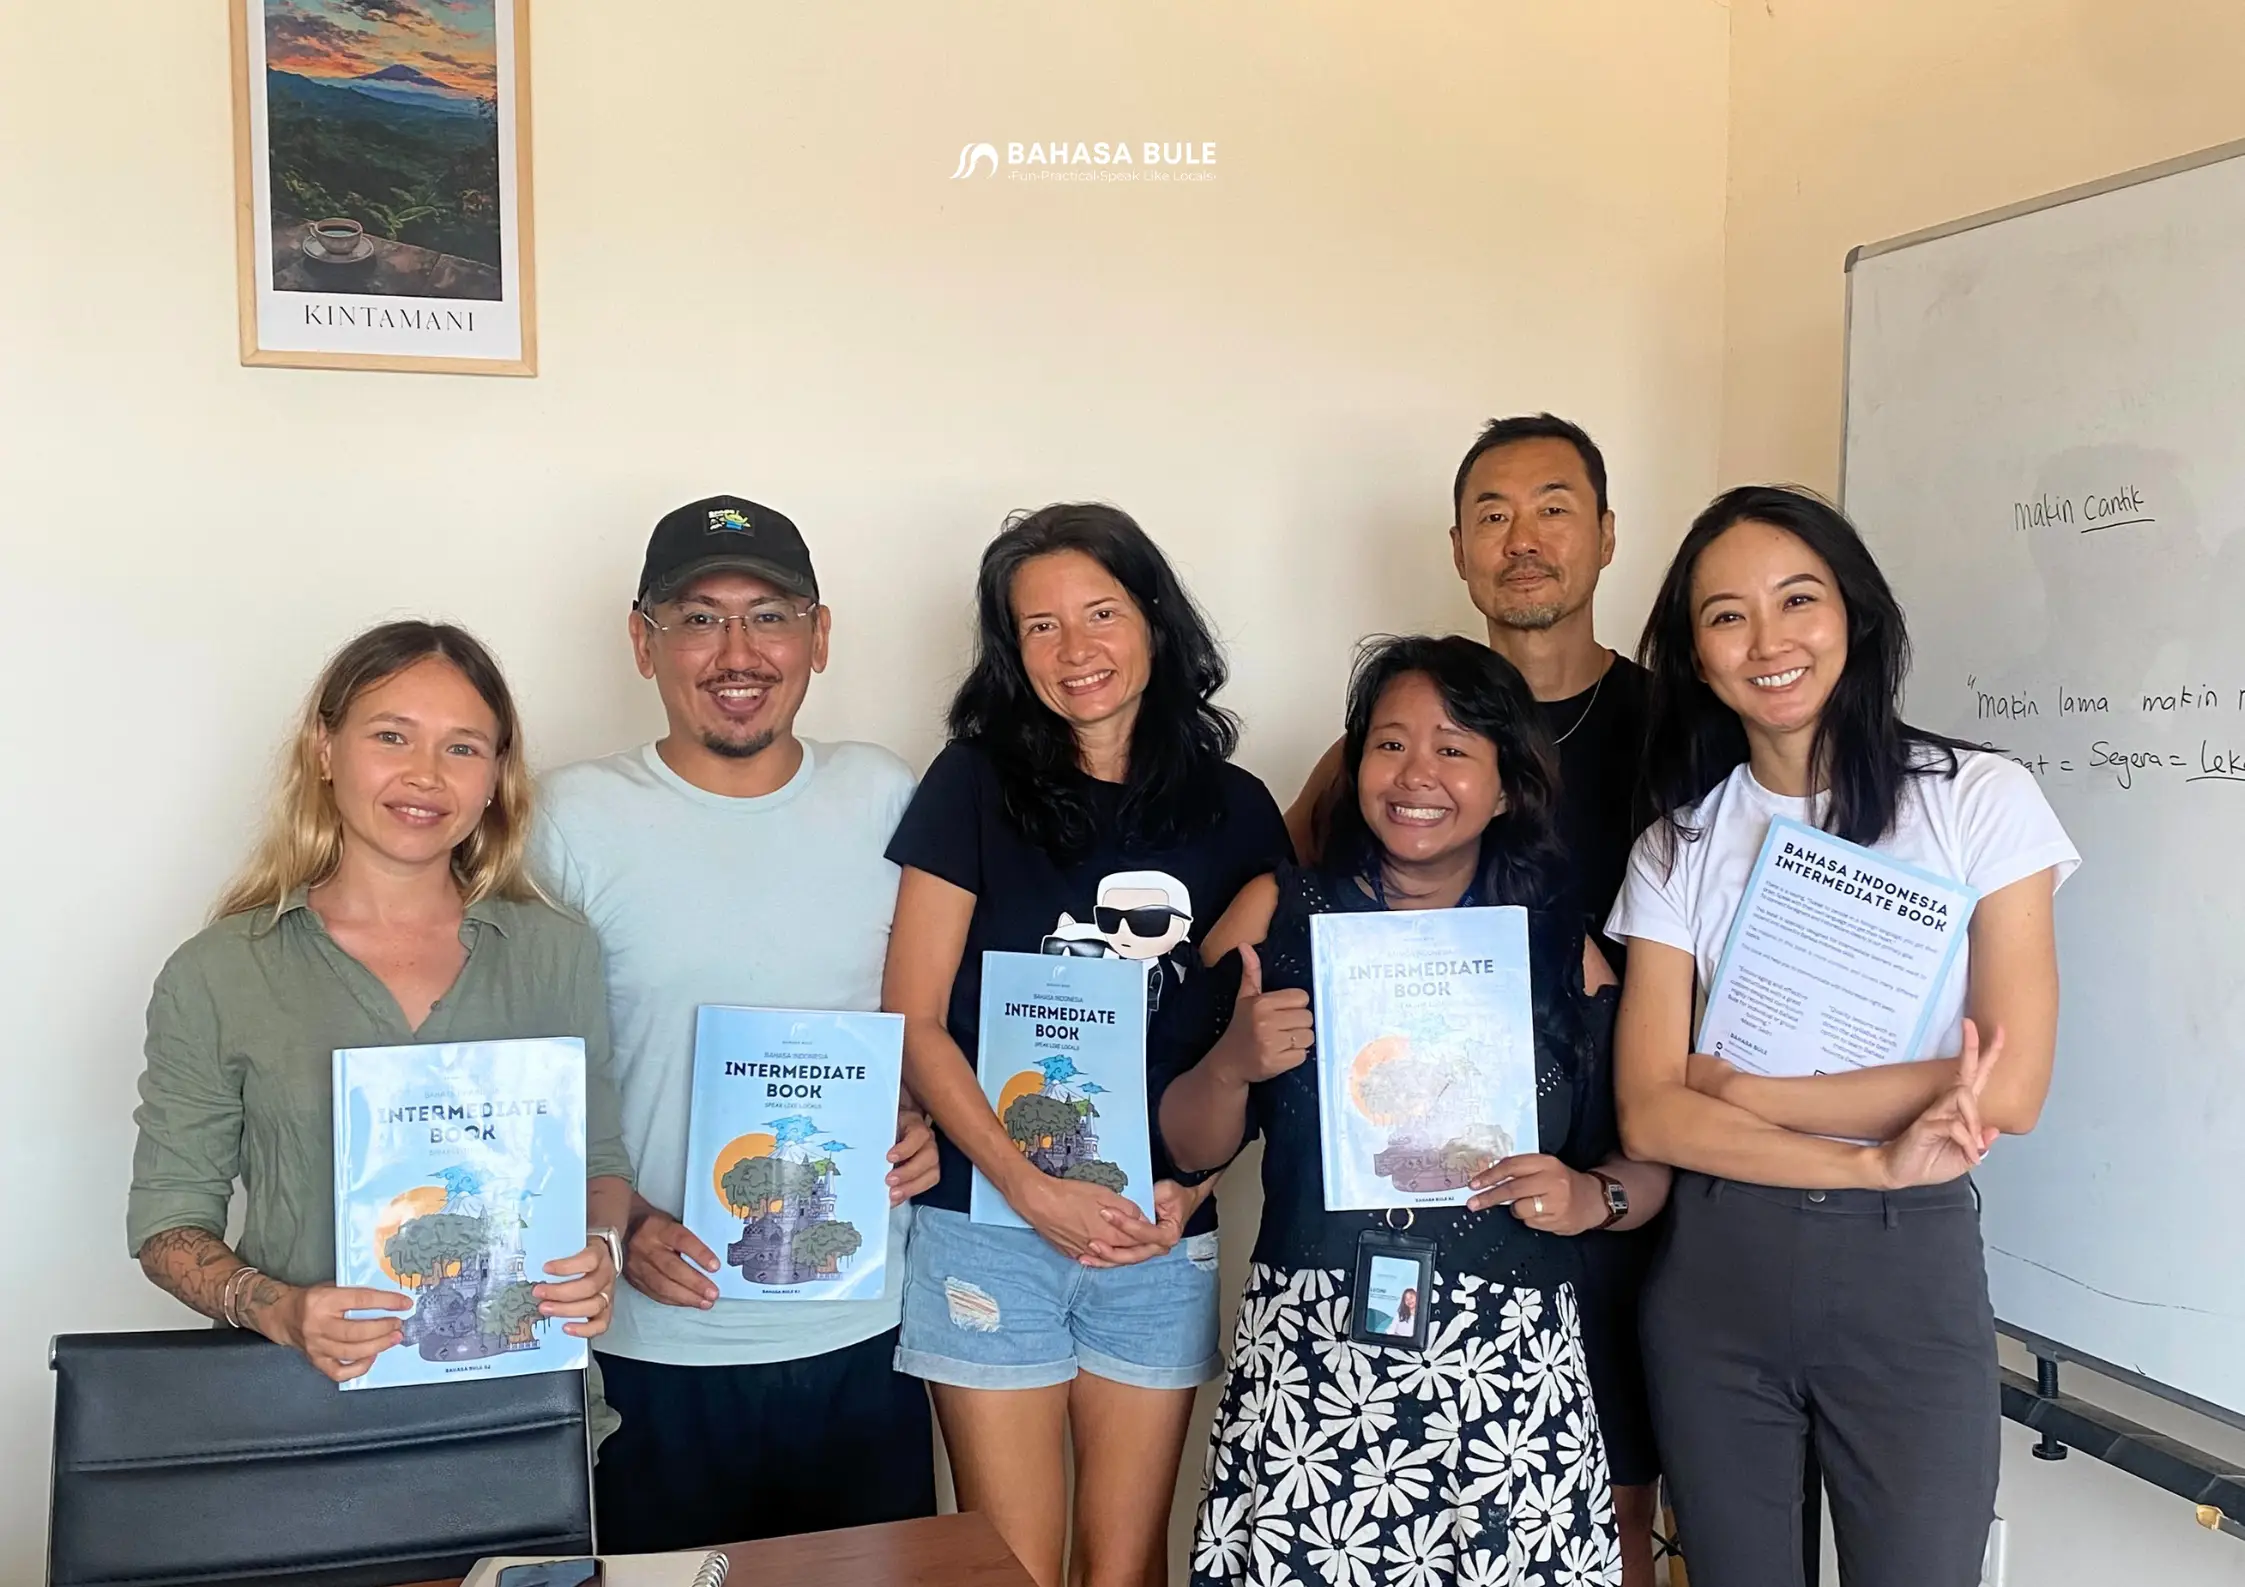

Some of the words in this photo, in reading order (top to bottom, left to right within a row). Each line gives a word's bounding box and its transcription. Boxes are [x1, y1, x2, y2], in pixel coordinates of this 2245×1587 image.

[305, 304, 474, 332] KINTAMANI
[2059, 686, 2109, 717] lama
[2142, 684, 2218, 713] makin
[1783, 842, 1849, 876] BAHASA
[1852, 869, 1950, 916] INDONESIA
[1774, 855, 1893, 911] INTERMEDIATE
[1897, 904, 1946, 932] BOOK
[1348, 959, 1494, 980] INTERMEDIATE
[1394, 981, 1451, 998] BOOK
[1004, 1002, 1116, 1025] INTERMEDIATE
[1035, 1023, 1080, 1041] BOOK
[724, 1061, 866, 1080] INTERMEDIATE
[766, 1083, 822, 1099] BOOK
[377, 1099, 548, 1124] INTERMEDIATE
[430, 1124, 496, 1144] BOOK
